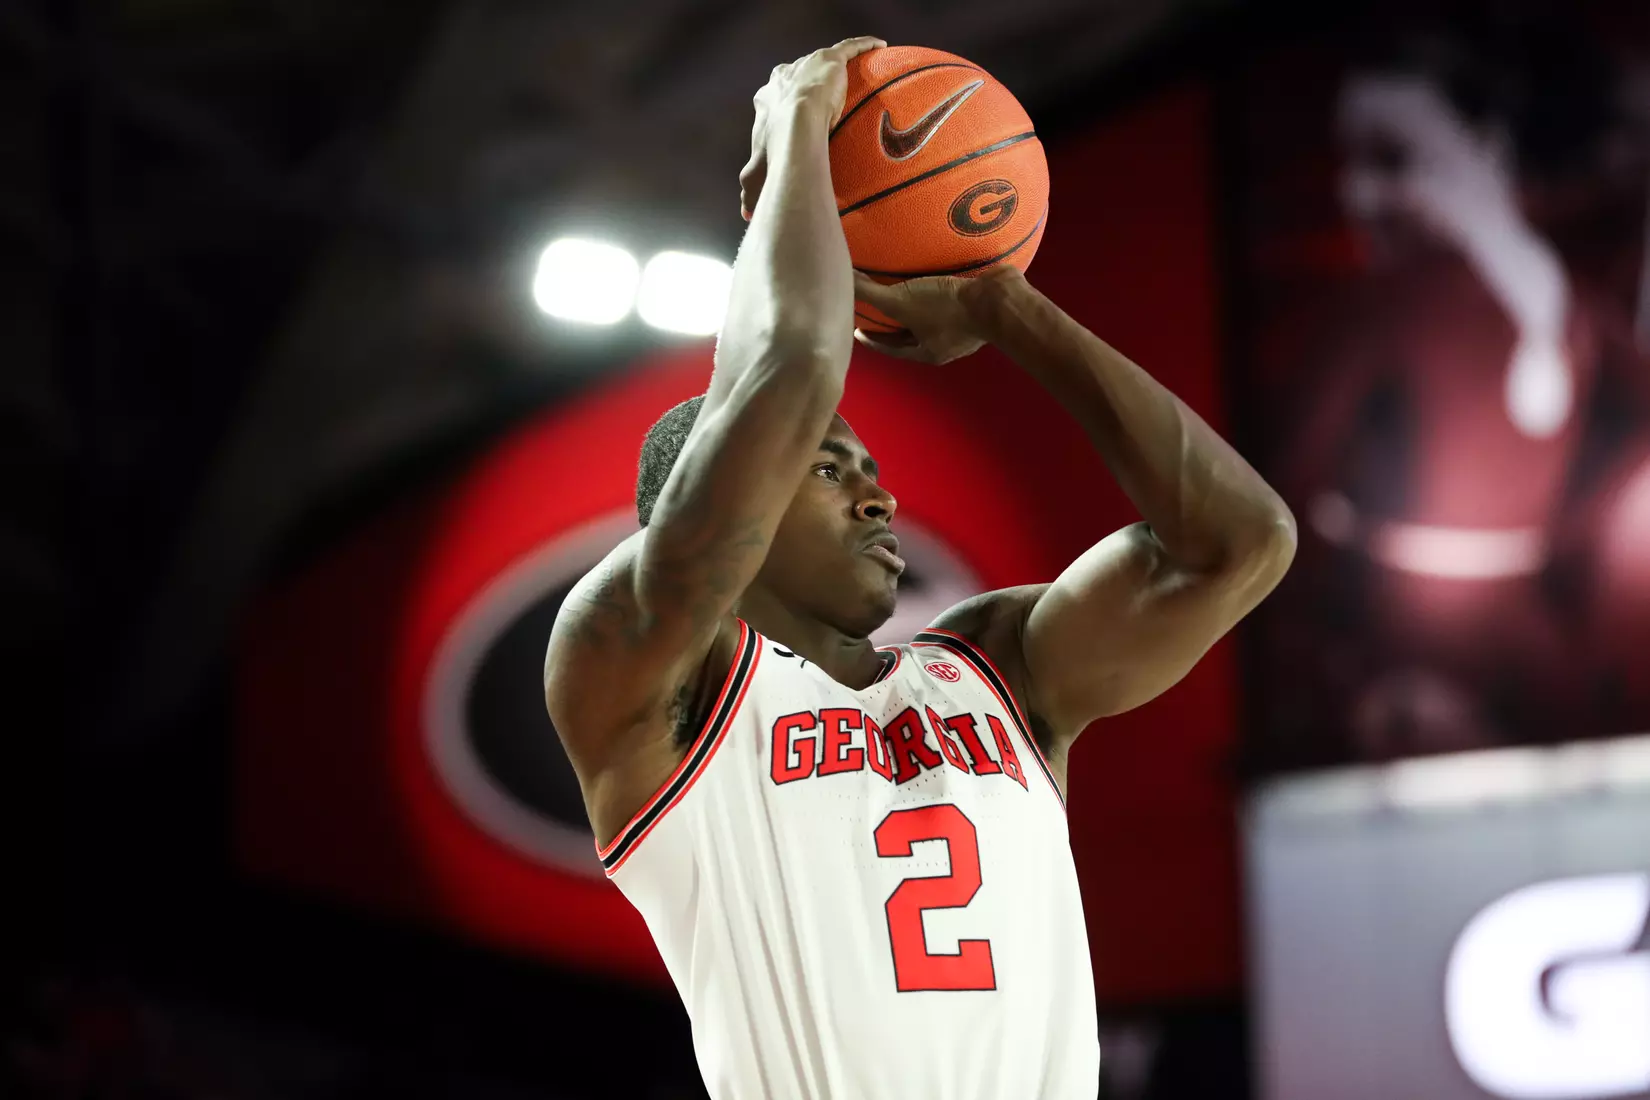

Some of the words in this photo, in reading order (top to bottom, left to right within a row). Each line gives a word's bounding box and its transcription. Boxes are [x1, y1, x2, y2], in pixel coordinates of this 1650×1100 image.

[949, 180, 1018, 236] G
[926, 663, 958, 680] SEC
[770, 704, 1029, 792] GEORGIA
[873, 803, 997, 992] 2
